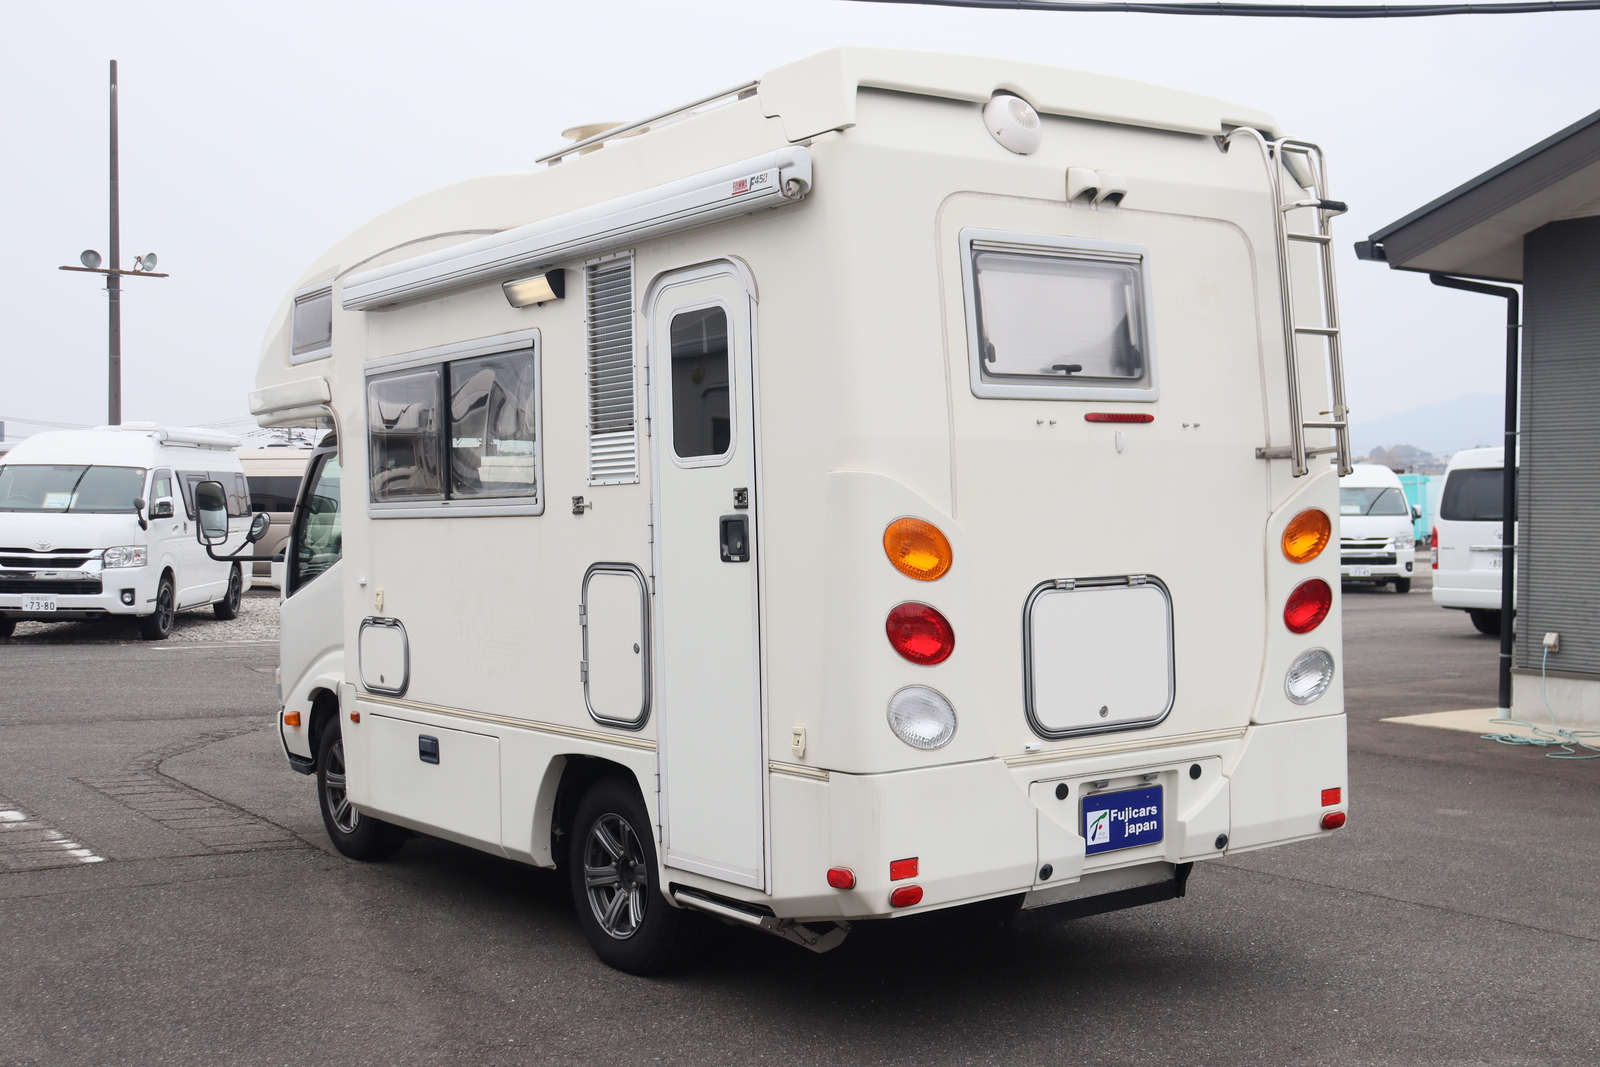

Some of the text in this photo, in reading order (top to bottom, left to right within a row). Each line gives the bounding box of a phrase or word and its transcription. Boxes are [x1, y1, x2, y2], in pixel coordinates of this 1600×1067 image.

[30, 601, 55, 610] 73-80
[1110, 806, 1157, 822] Fujicars
[1124, 820, 1157, 837] japan
